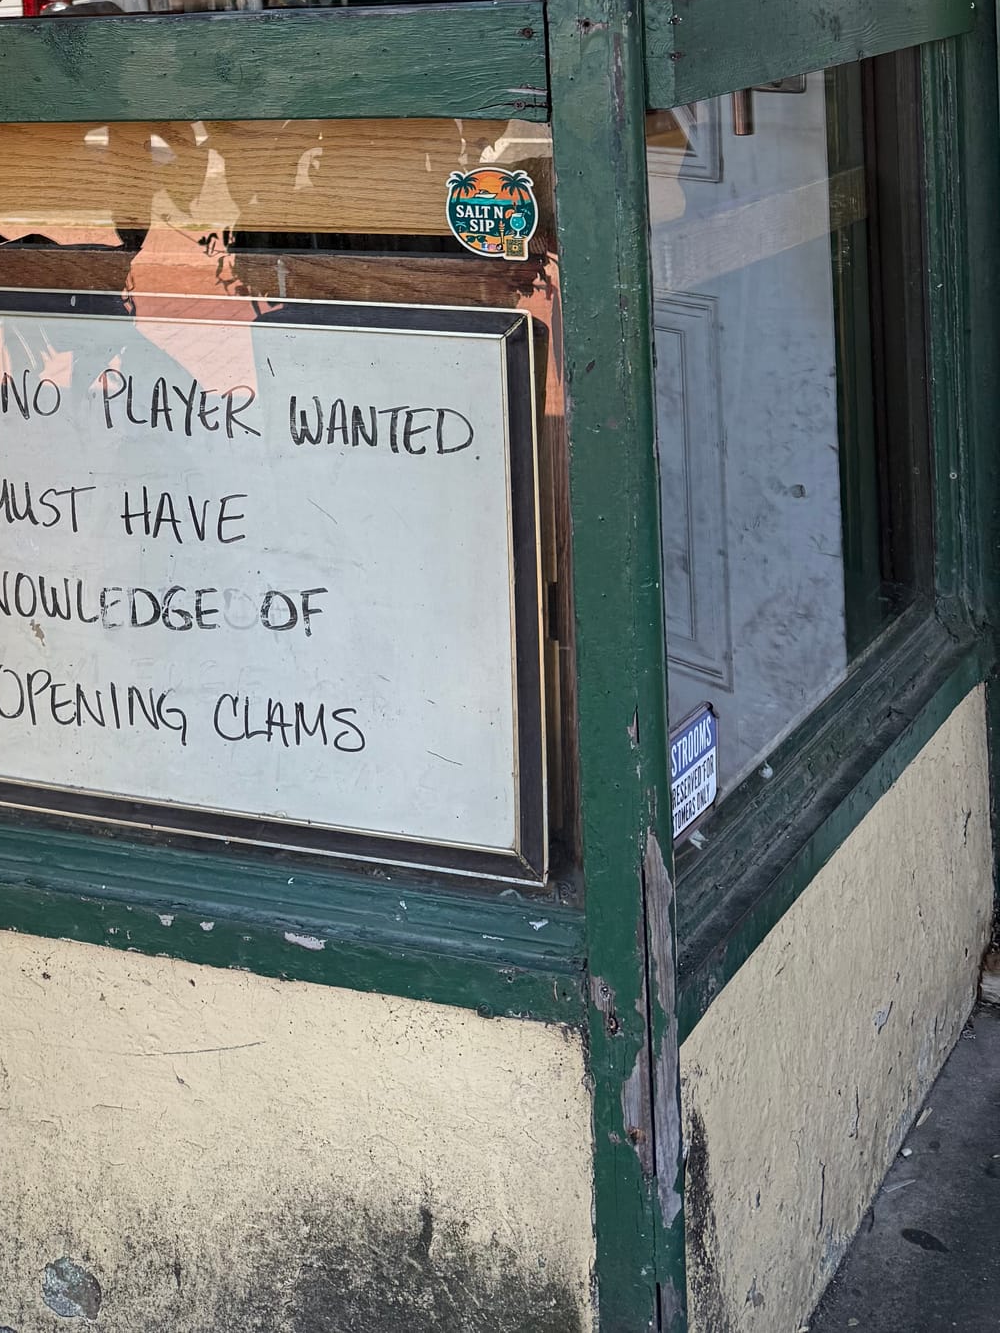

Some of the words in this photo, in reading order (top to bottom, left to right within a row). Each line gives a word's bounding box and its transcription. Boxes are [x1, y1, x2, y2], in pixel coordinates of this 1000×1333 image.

[456, 205, 491, 218] SALT
[494, 206, 504, 218] N
[469, 219, 495, 232] SIP
[98, 367, 262, 438] PLAYER
[120, 486, 249, 545] HAVE
[259, 586, 329, 637] OF
[213, 692, 366, 753] CLAMS
[671, 715, 712, 778] STROOMS
[672, 796, 695, 833] TOMERS
